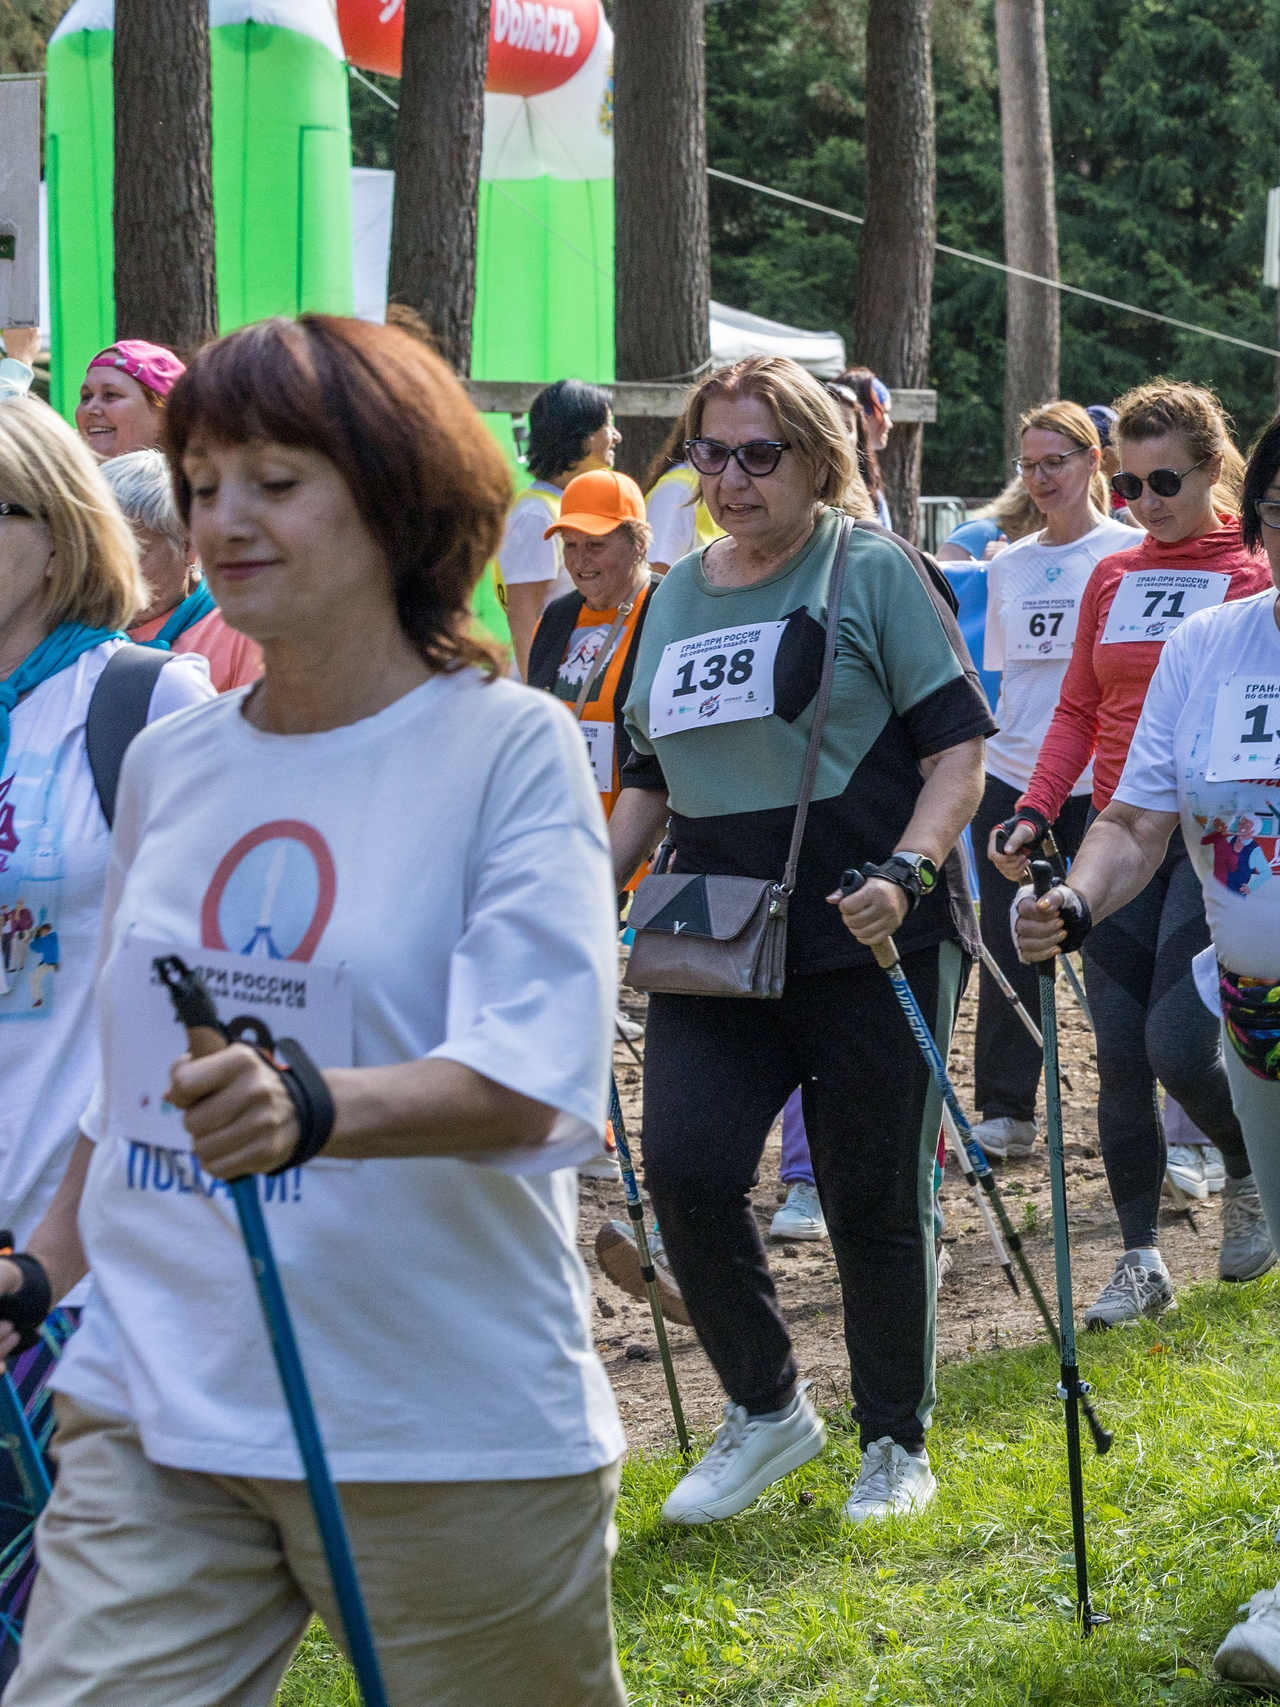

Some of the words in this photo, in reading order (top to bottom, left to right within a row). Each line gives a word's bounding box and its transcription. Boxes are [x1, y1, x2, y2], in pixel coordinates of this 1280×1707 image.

[1178, 577, 1209, 585] РОССИИ
[1142, 591, 1185, 618] 71
[1029, 612, 1064, 636] 67
[681, 636, 722, 653] ГРАН-ПРИ
[724, 629, 761, 643] РОССИИ
[688, 644, 722, 656] северной
[723, 639, 747, 649] ходьбе
[672, 648, 755, 698] 138
[232, 971, 306, 994] РОССИИ
